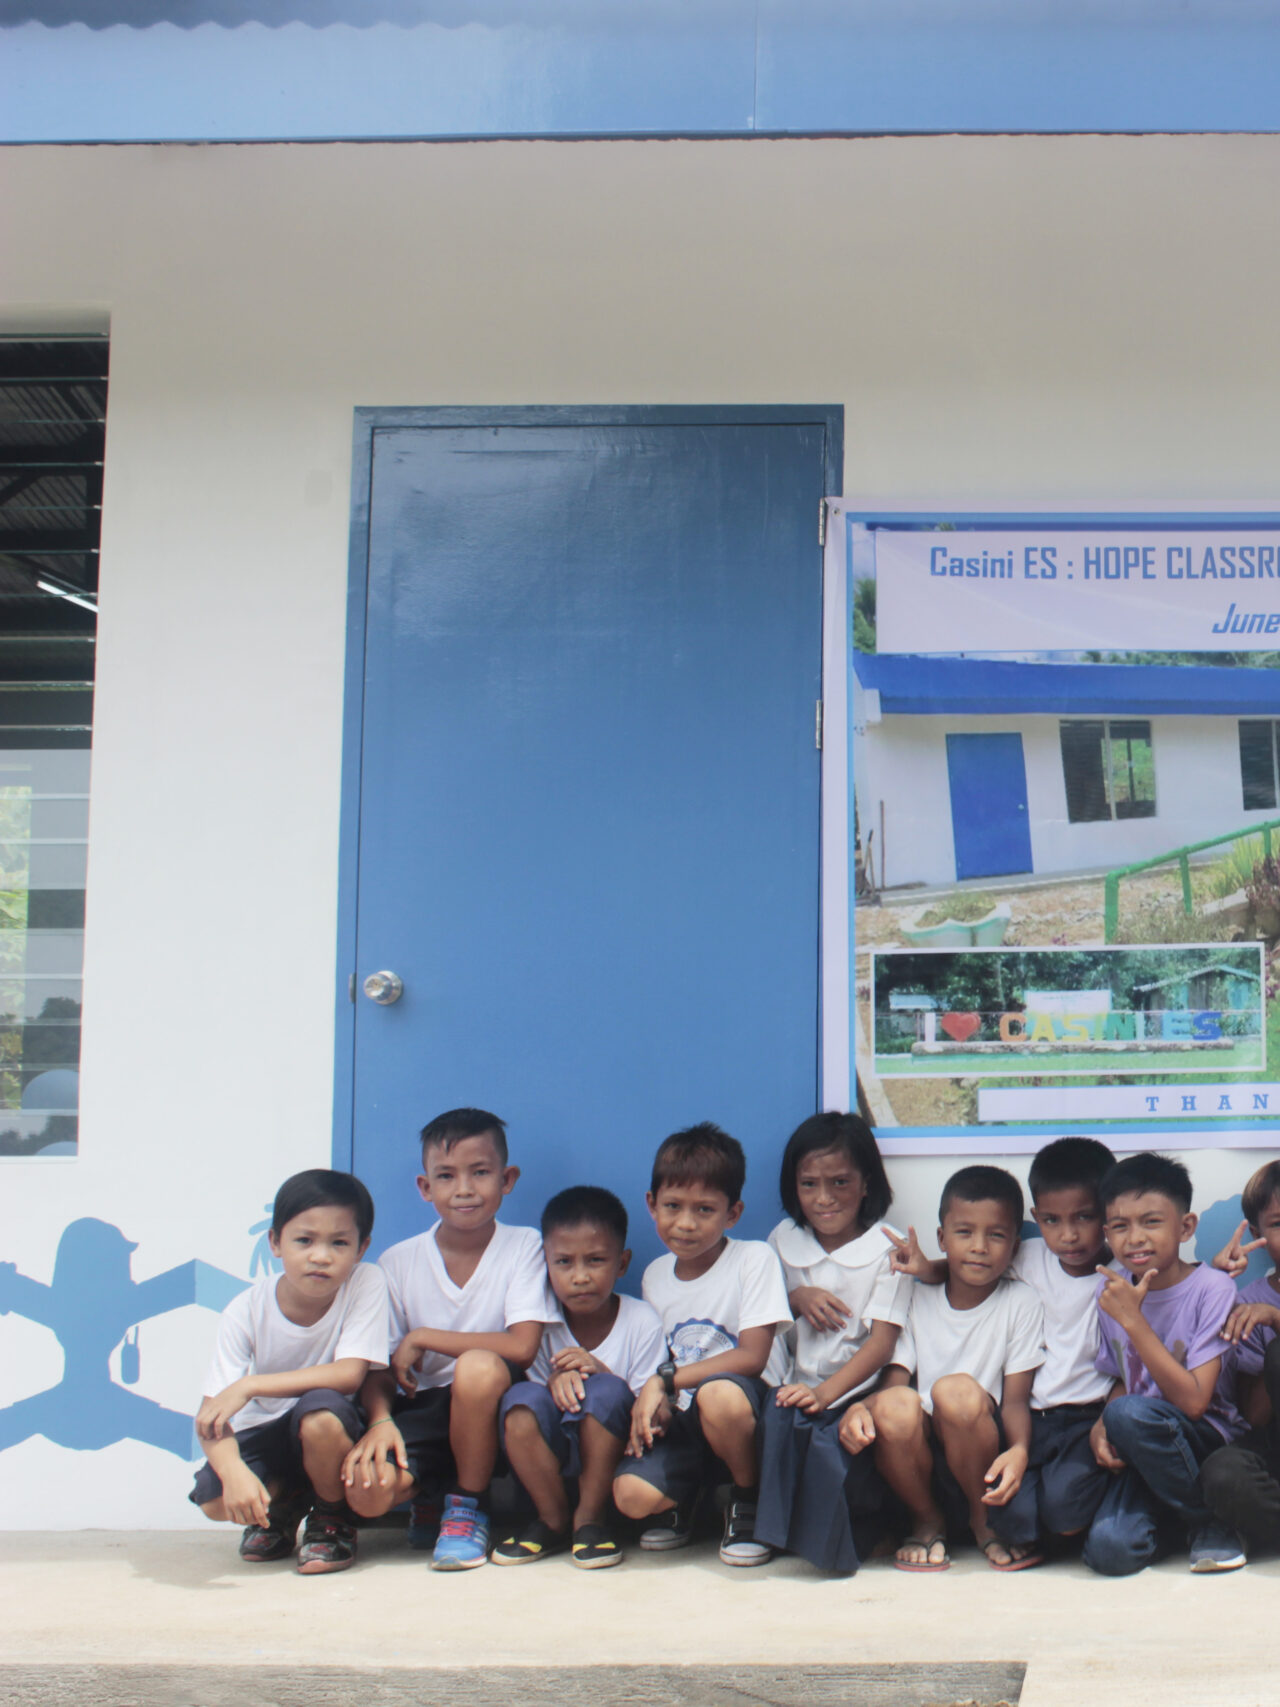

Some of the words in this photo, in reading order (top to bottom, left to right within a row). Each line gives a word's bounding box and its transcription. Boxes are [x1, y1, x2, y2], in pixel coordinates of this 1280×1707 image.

[930, 546, 1014, 579] Casini
[1024, 547, 1058, 580] ES
[1083, 546, 1157, 580] HOPE
[924, 1011, 937, 1043] I
[1162, 1011, 1223, 1042] ES
